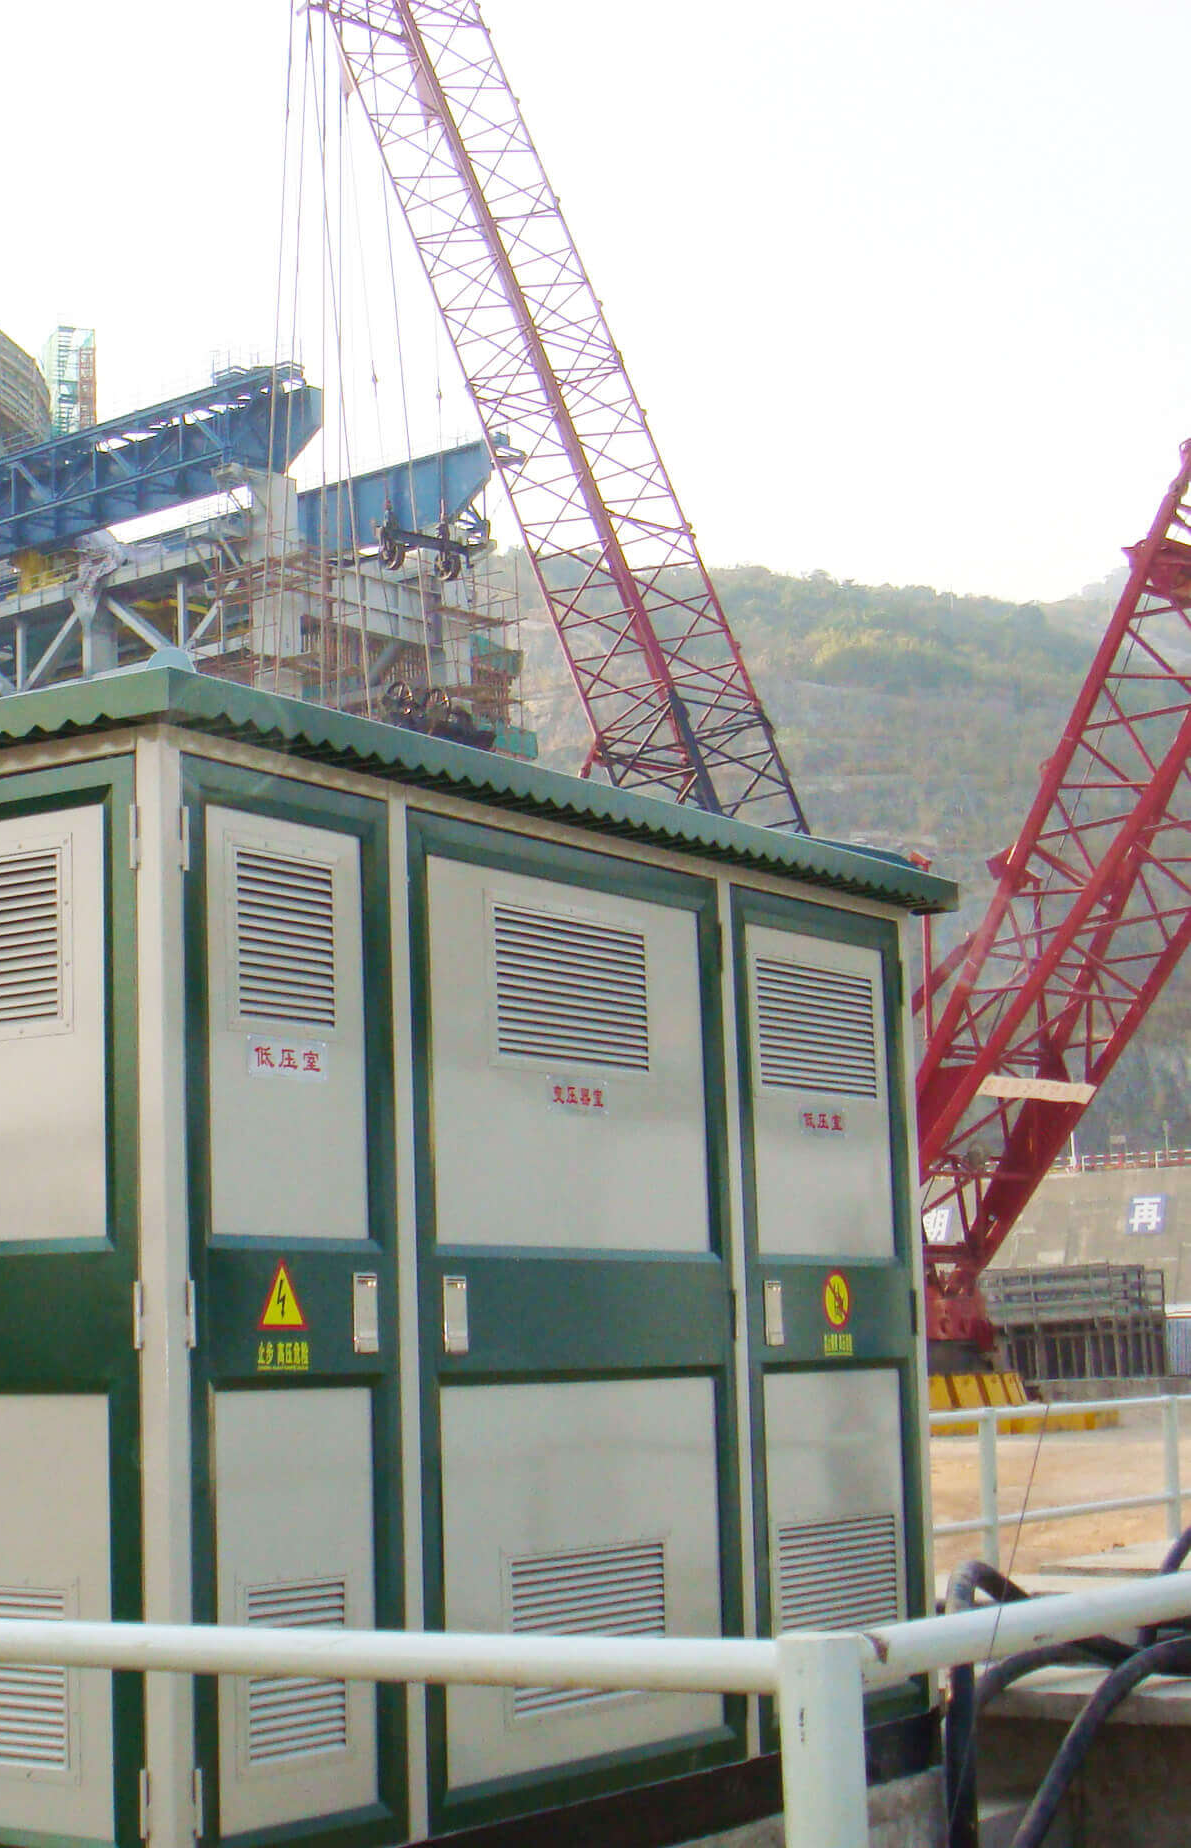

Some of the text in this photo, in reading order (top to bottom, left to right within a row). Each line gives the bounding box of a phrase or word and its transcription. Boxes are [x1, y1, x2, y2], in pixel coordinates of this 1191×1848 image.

[254, 1046, 321, 1072] 低压室
[553, 1085, 604, 1107] 变压器室
[802, 1112, 843, 1131] 低压室
[1129, 1197, 1161, 1232] 再
[258, 1340, 308, 1365] 止步 高压危险
